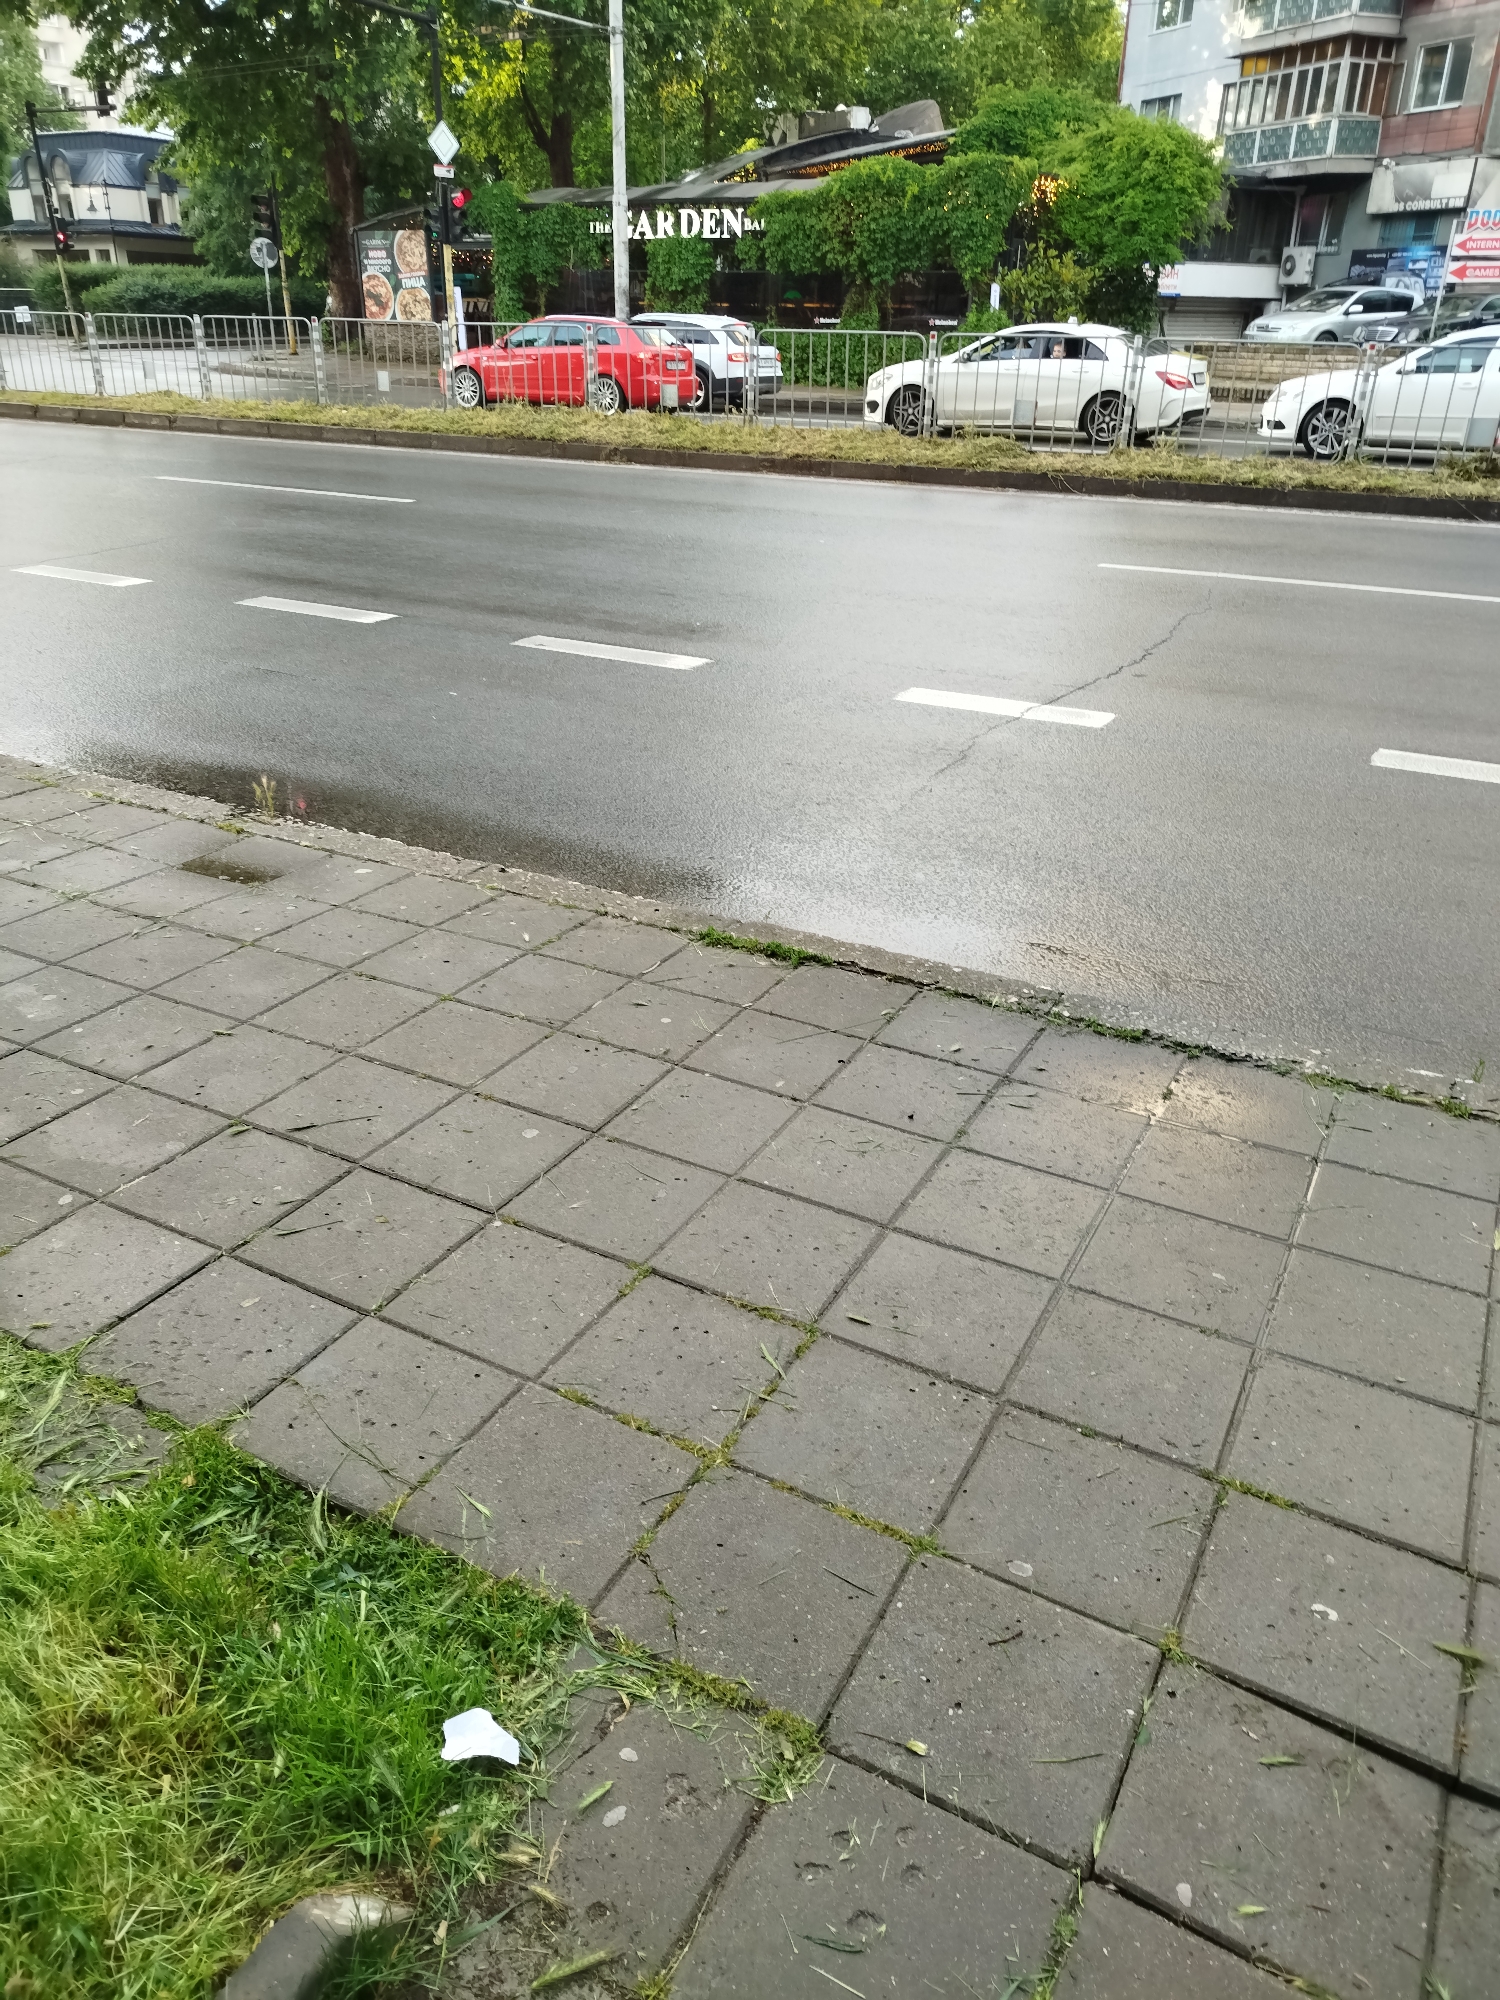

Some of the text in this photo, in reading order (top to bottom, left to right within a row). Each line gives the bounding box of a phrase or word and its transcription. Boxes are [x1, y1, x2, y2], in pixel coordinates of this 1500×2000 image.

[1405, 198, 1447, 211] CONSULT
[590, 221, 612, 234] THE
[1466, 240, 1500, 249] INTERN
[1466, 268, 1500, 278] GAMES
[402, 277, 426, 289] ПИЦА
